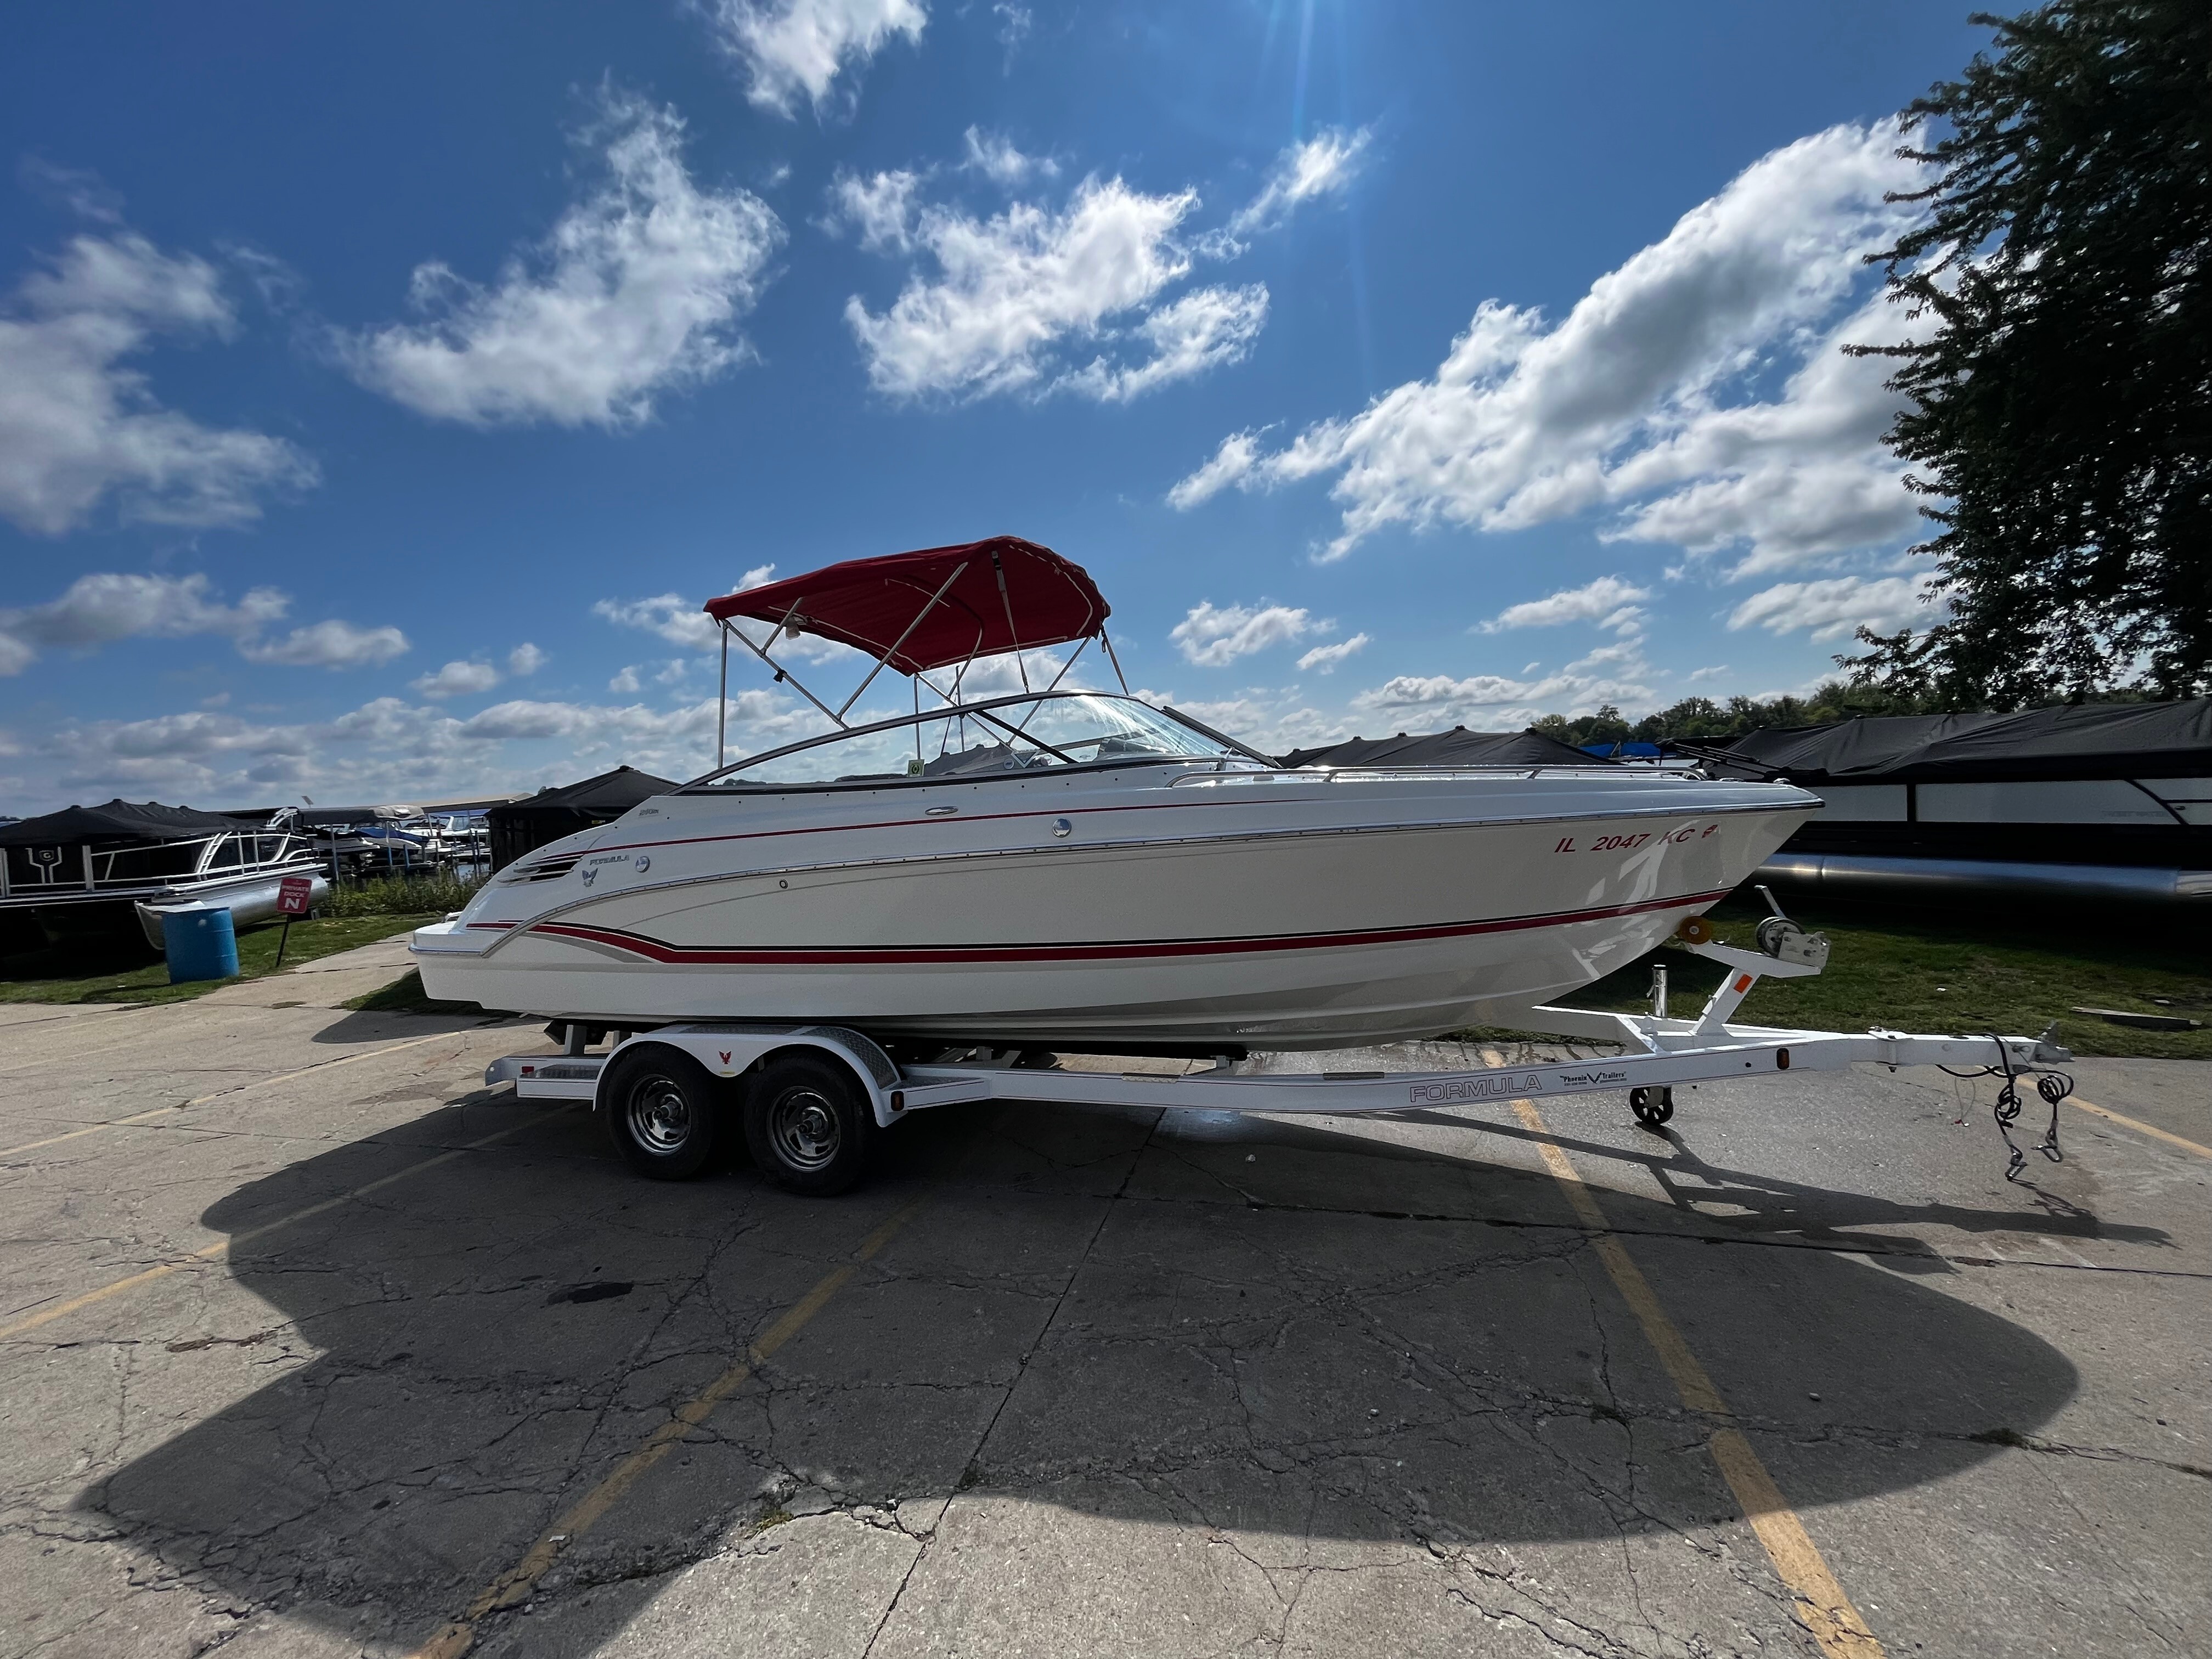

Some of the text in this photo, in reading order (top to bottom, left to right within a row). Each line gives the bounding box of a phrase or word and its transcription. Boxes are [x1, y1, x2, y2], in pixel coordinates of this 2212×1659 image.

[1554, 838, 1576, 853] IL
[1590, 833, 1651, 851] 2047
[1657, 828, 1696, 845] KC
[590, 855, 630, 866] FORMULA
[284, 898, 300, 909] N
[1410, 1074, 1543, 1103] FORMULA
